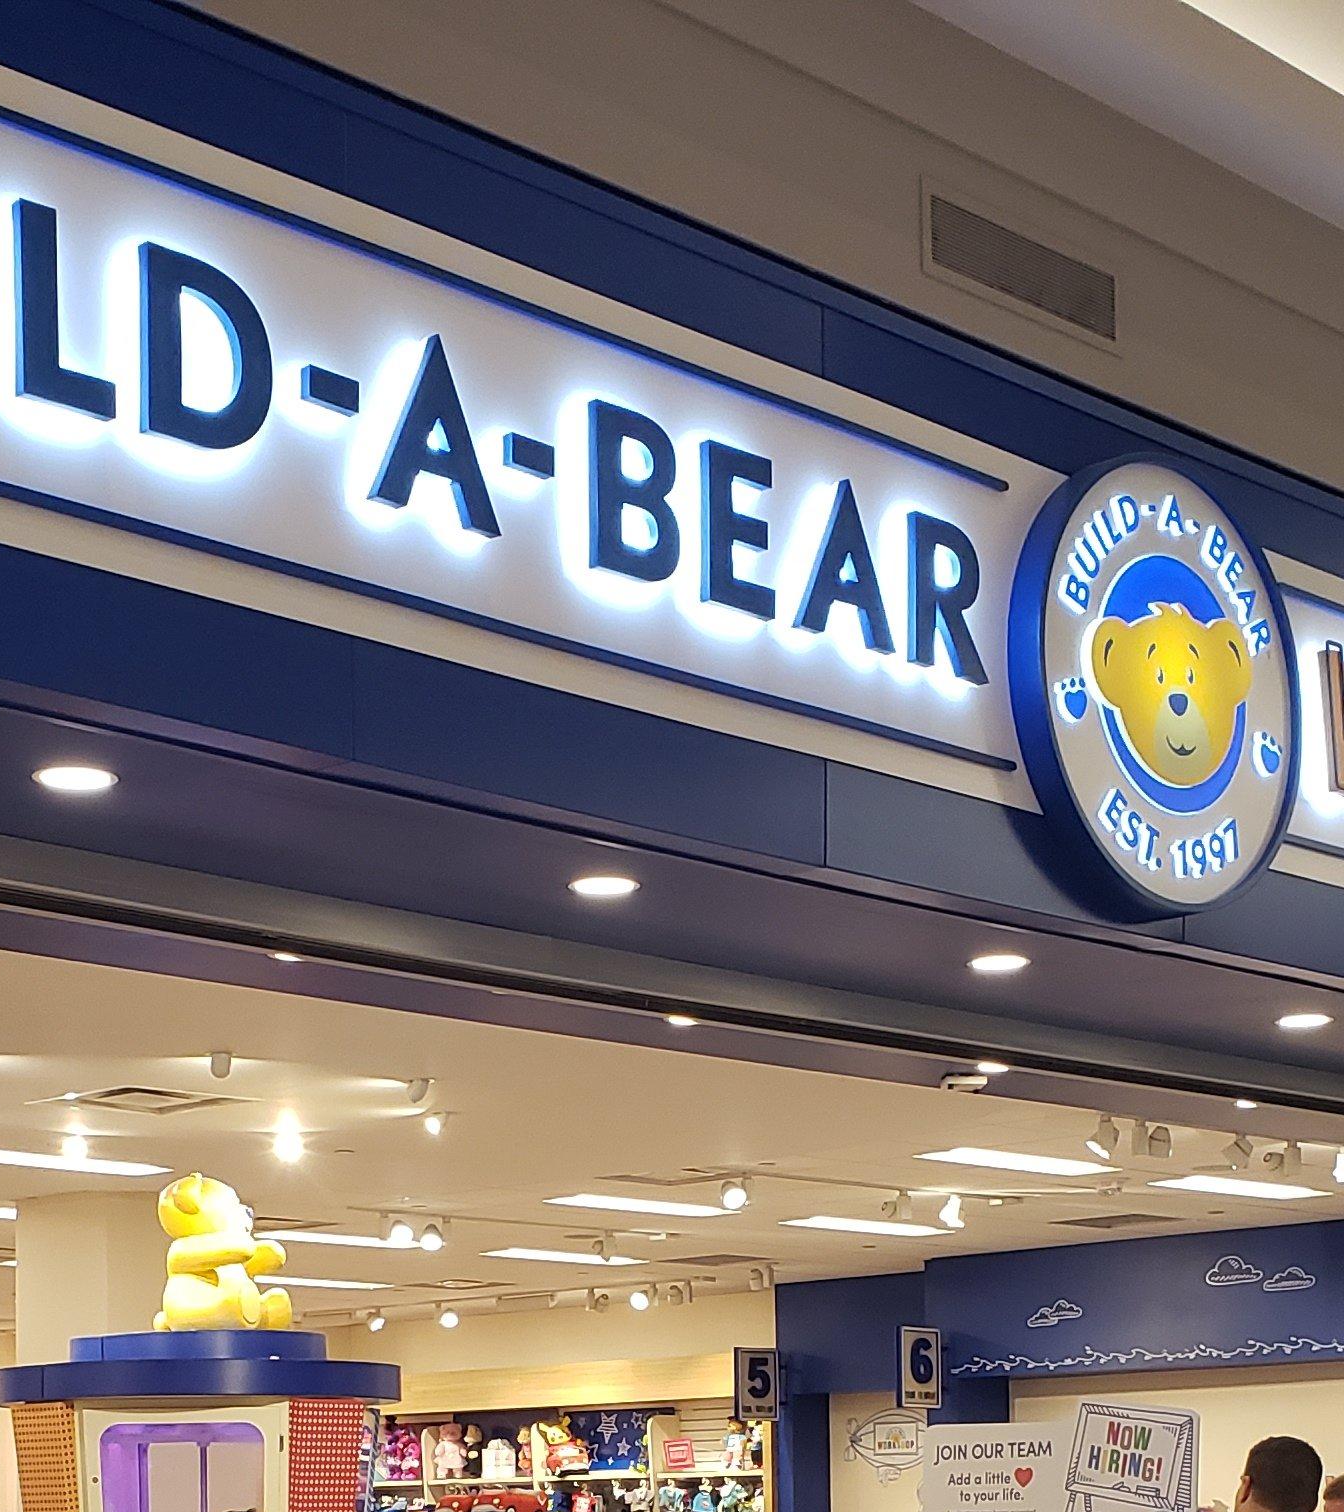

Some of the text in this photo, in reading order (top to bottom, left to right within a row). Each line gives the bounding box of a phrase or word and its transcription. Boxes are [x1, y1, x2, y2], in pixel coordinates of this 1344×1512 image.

[1058, 493, 1272, 657] BUILD-A-BEAR
[1098, 787, 1240, 879] EST. 1997
[747, 1357, 771, 1398] 5
[910, 1337, 934, 1384] 6
[933, 1440, 1052, 1466] JOIN OUR TEAM
[1106, 1421, 1152, 1450] NOW
[947, 1471, 1011, 1486] Add a little
[1087, 1445, 1163, 1482] HIRING!
[959, 1487, 1024, 1505] to your life.
